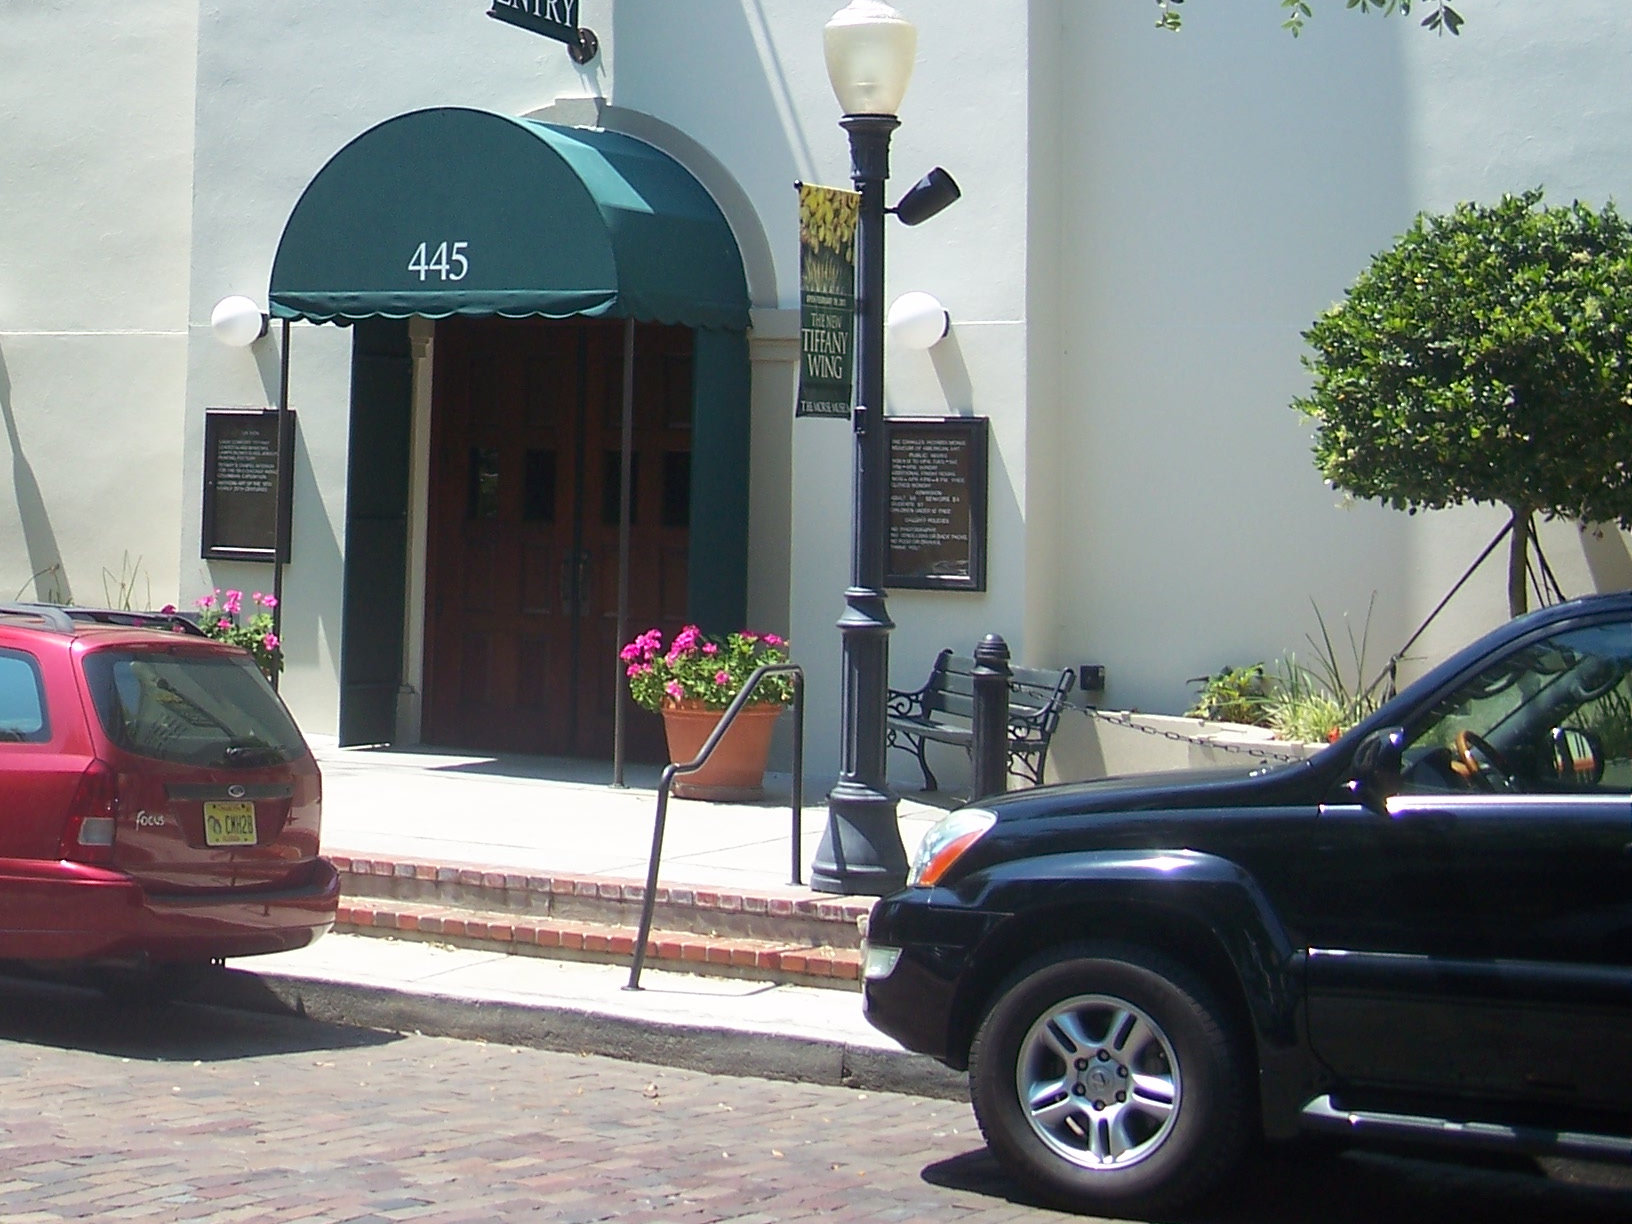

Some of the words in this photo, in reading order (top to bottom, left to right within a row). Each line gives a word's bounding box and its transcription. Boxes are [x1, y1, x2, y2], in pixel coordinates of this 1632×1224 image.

[407, 241, 469, 281] 445
[810, 313, 825, 328] THE
[826, 314, 842, 329] NEW
[801, 328, 848, 355] TIFFANY
[808, 354, 843, 380] WING
